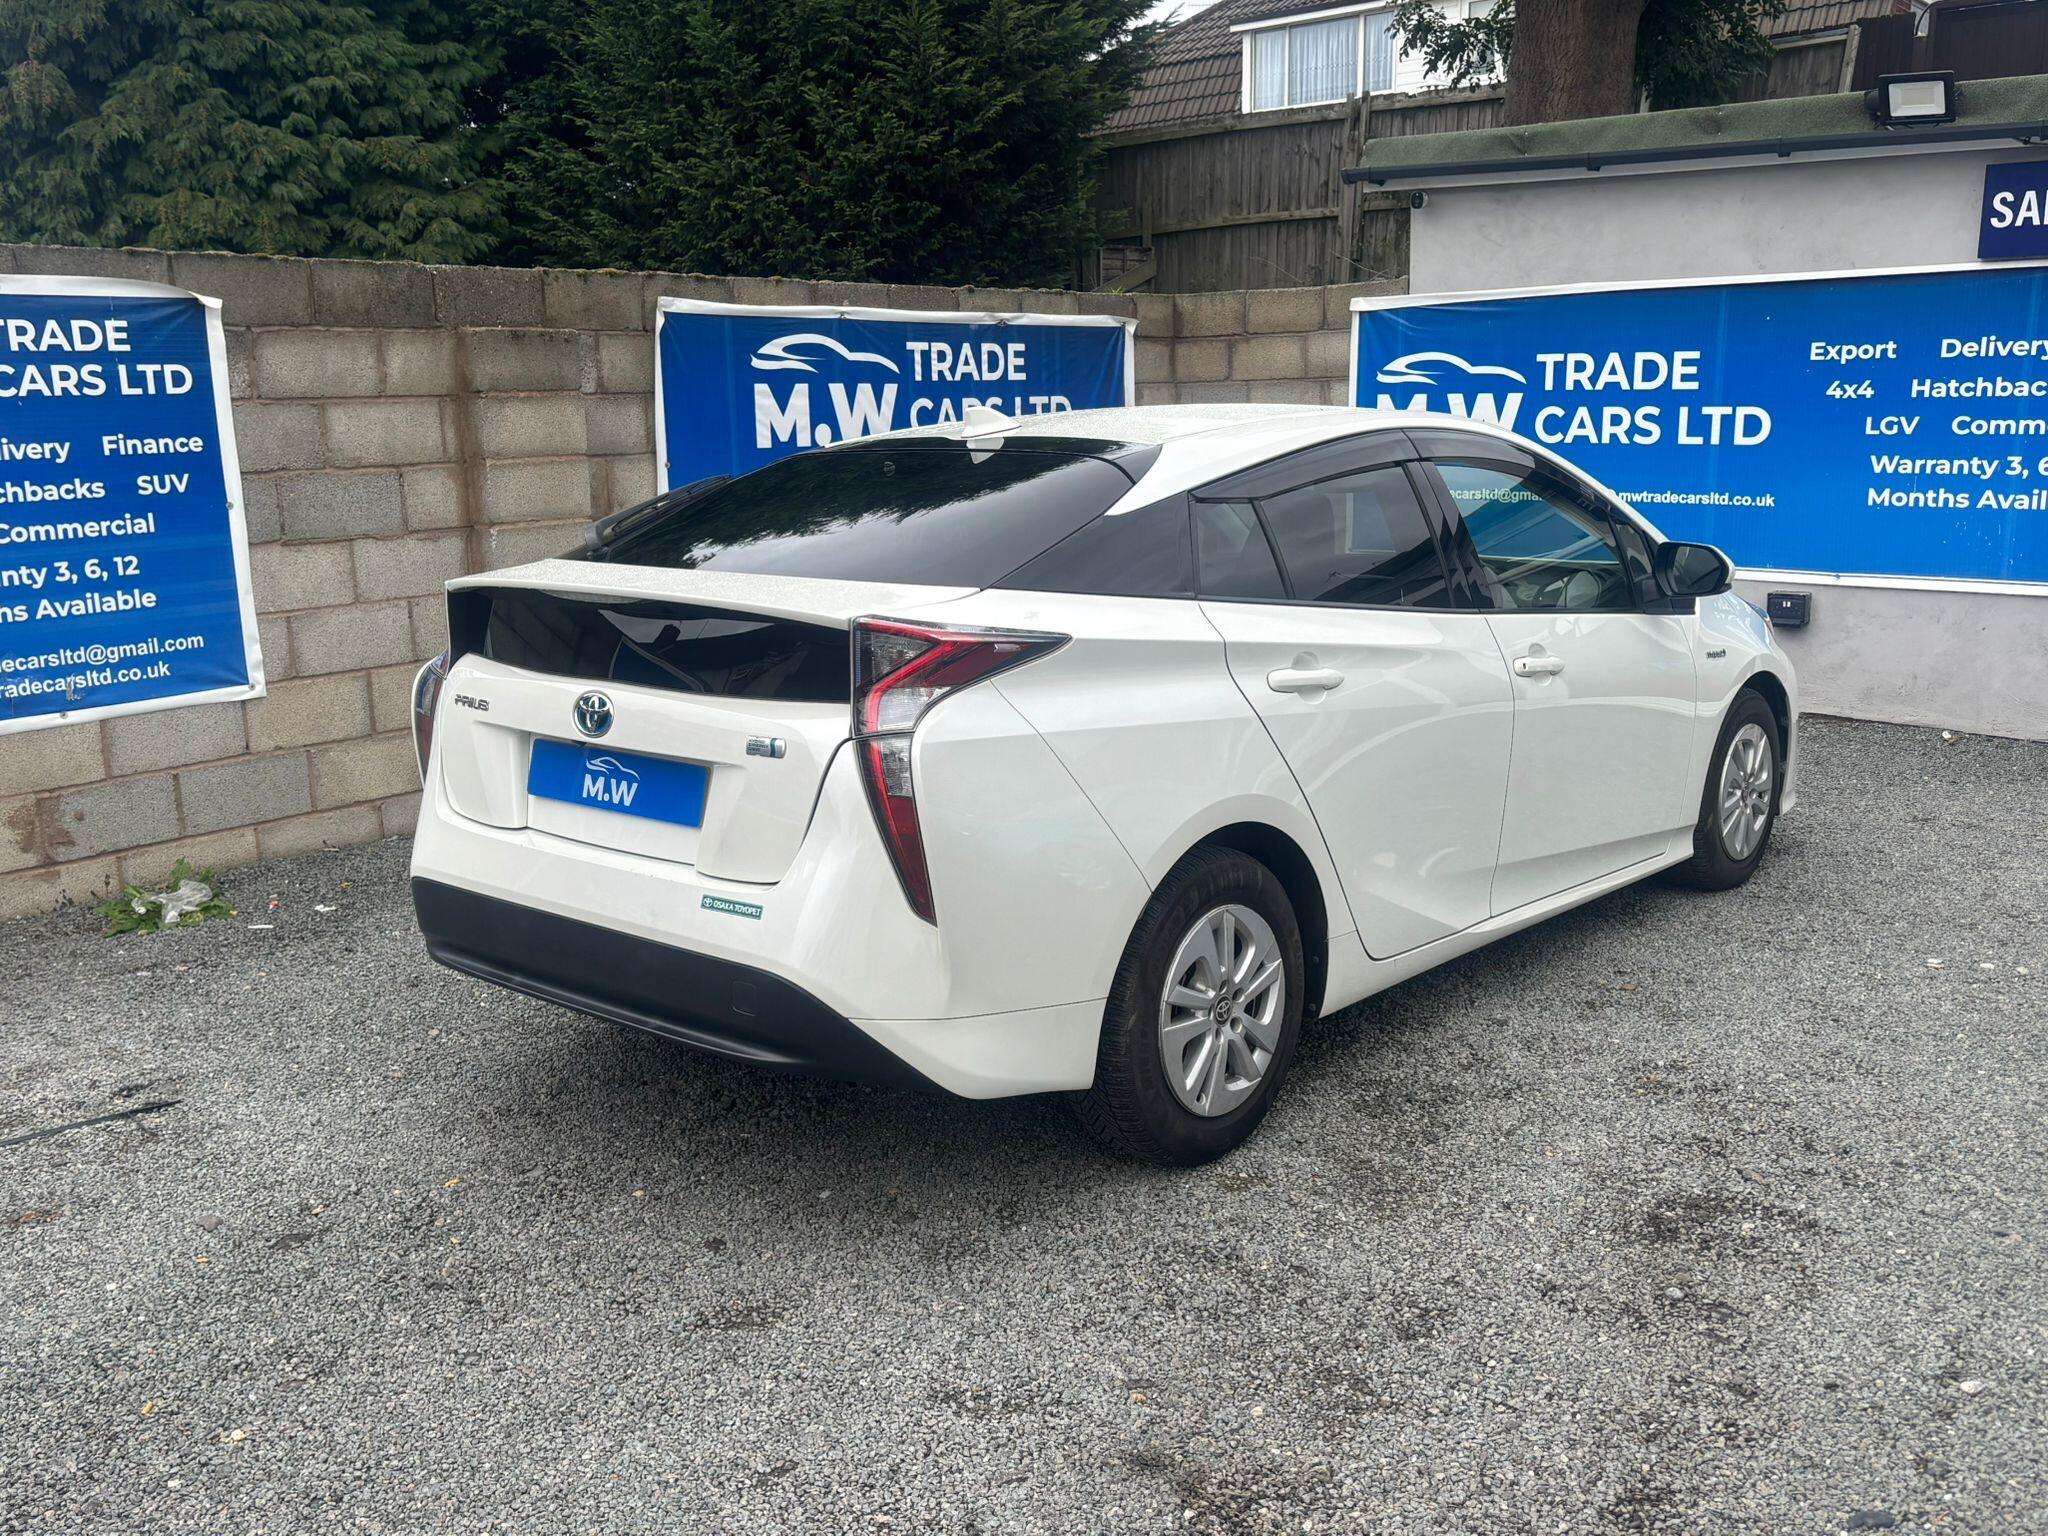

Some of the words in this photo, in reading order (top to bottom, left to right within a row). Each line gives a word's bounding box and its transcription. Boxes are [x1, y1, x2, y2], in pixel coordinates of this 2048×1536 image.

[1990, 190, 2048, 229] SA
[0, 319, 131, 351] RADE
[905, 341, 1027, 382] TRADE
[1809, 340, 1898, 365] Export
[118, 364, 194, 395] LTD
[1536, 351, 1701, 391] TRADE
[1825, 379, 1876, 399] 4x4
[753, 383, 899, 449] M.W
[1534, 406, 1662, 444] CARS
[1677, 406, 1773, 446] LTD
[1864, 416, 1920, 436] LGV
[1951, 415, 2048, 436] Comm
[0, 436, 70, 464] ivery
[102, 434, 204, 456] Finance
[1870, 455, 1999, 480] Warranty
[2005, 456, 2029, 480] 3,
[136, 473, 190, 496] SUV
[1867, 488, 1970, 508] Months
[53, 561, 78, 584] 3,
[84, 558, 109, 582] 6,
[113, 555, 141, 578] 12
[36, 589, 157, 620] Available
[582, 773, 639, 807] M.W
[713, 900, 734, 911] OSAKA
